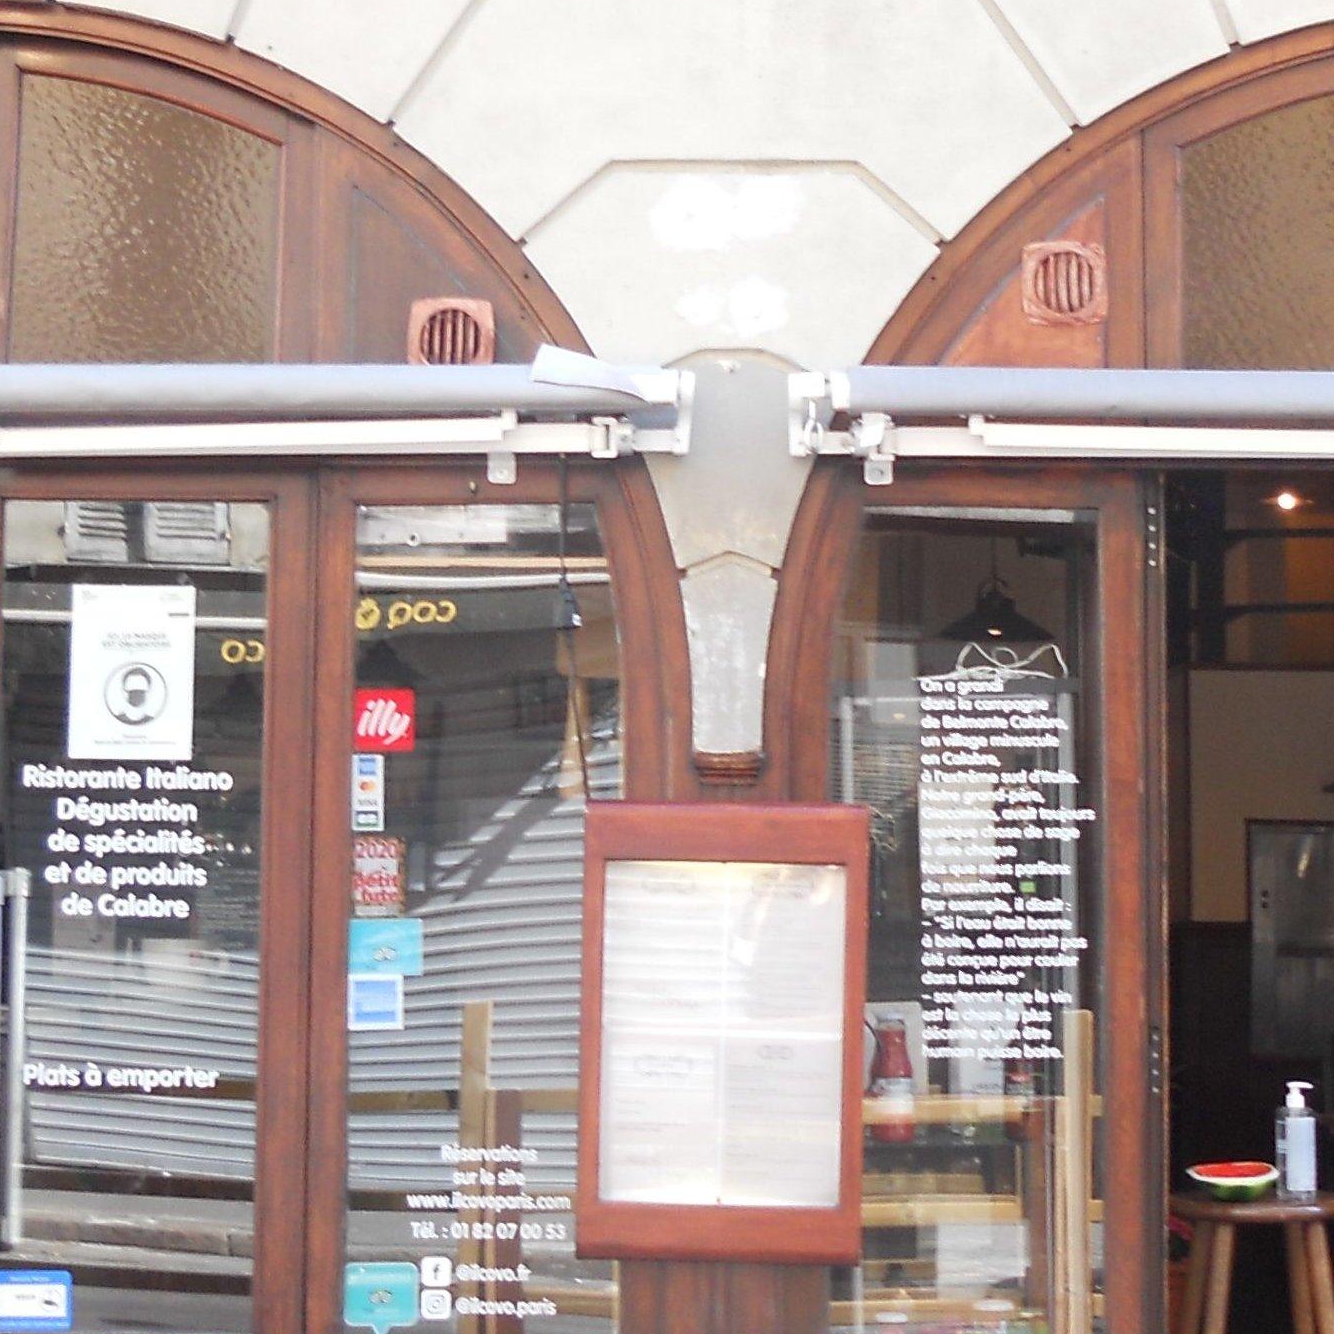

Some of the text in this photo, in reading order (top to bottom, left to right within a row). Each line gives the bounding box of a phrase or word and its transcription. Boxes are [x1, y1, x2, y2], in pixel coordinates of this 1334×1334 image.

[357, 698, 410, 745] illy
[22, 764, 234, 791] Ristorante Italiano
[56, 795, 198, 826] Dégustation
[47, 828, 206, 858] de spécialités
[44, 861, 208, 890] et de produits
[61, 892, 190, 919] de Calabre
[23, 1062, 220, 1093] Plats à emporter
[441, 1143, 538, 1162] Réservations
[452, 1168, 525, 1185] sur le site
[496, 1223, 517, 1239] 07
